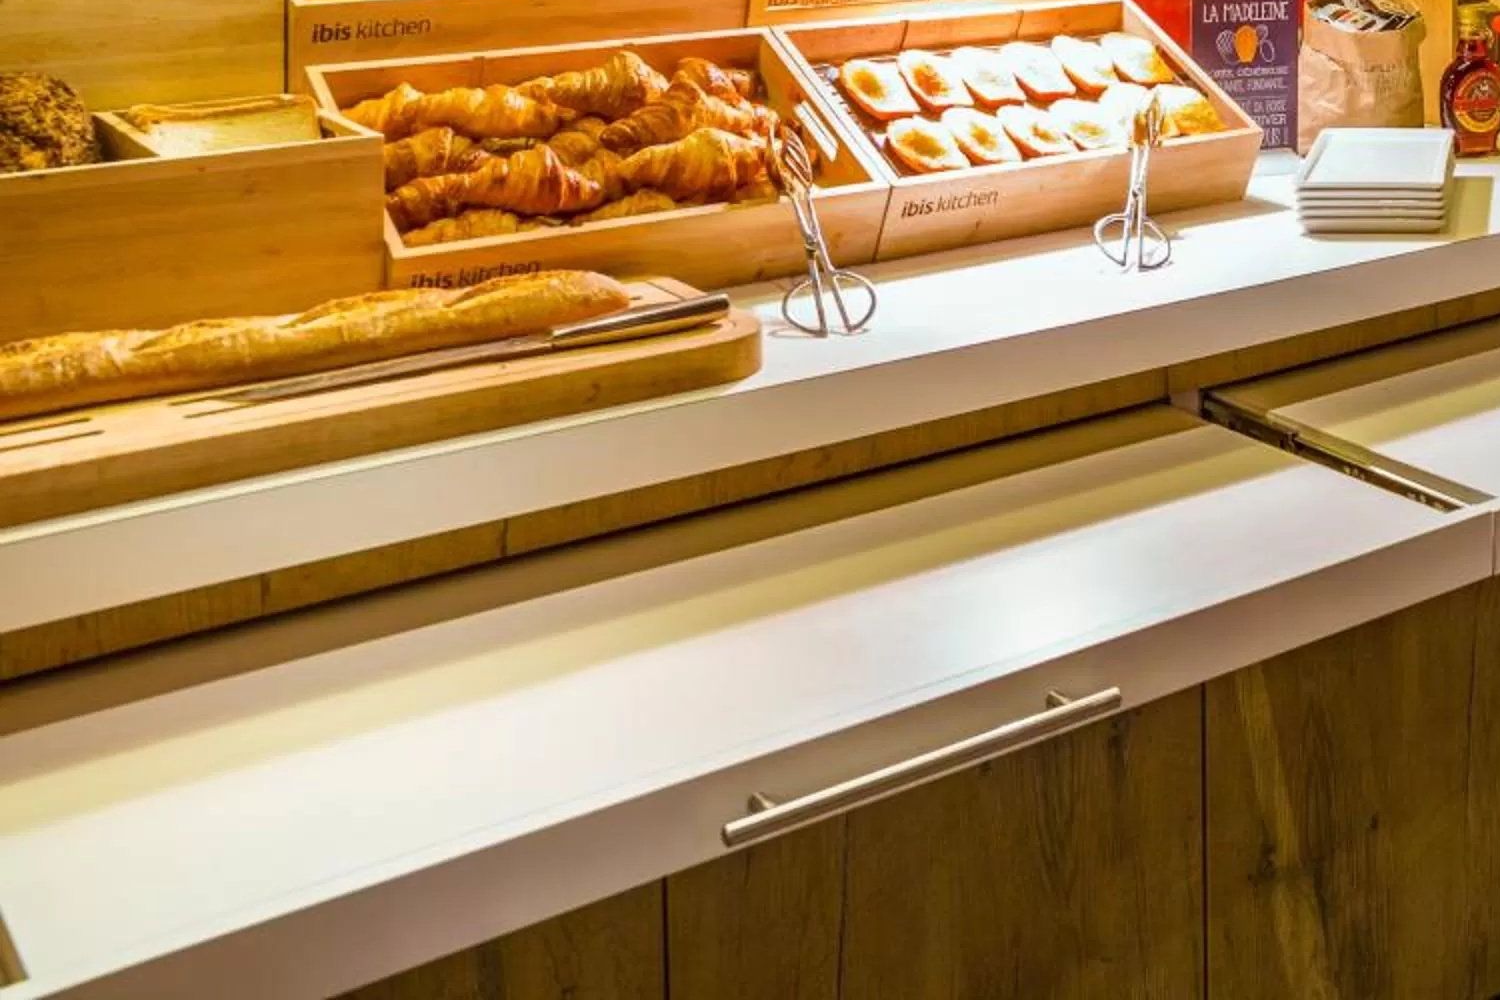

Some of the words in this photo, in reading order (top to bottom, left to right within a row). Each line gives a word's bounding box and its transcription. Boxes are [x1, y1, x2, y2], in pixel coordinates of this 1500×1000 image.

[1203, 4, 1219, 23] LA
[1223, 1, 1289, 22] MADELEINE
[311, 22, 352, 44] ibis
[355, 17, 432, 41] kitchen
[900, 199, 934, 219] ibis
[935, 191, 999, 213] kitchen
